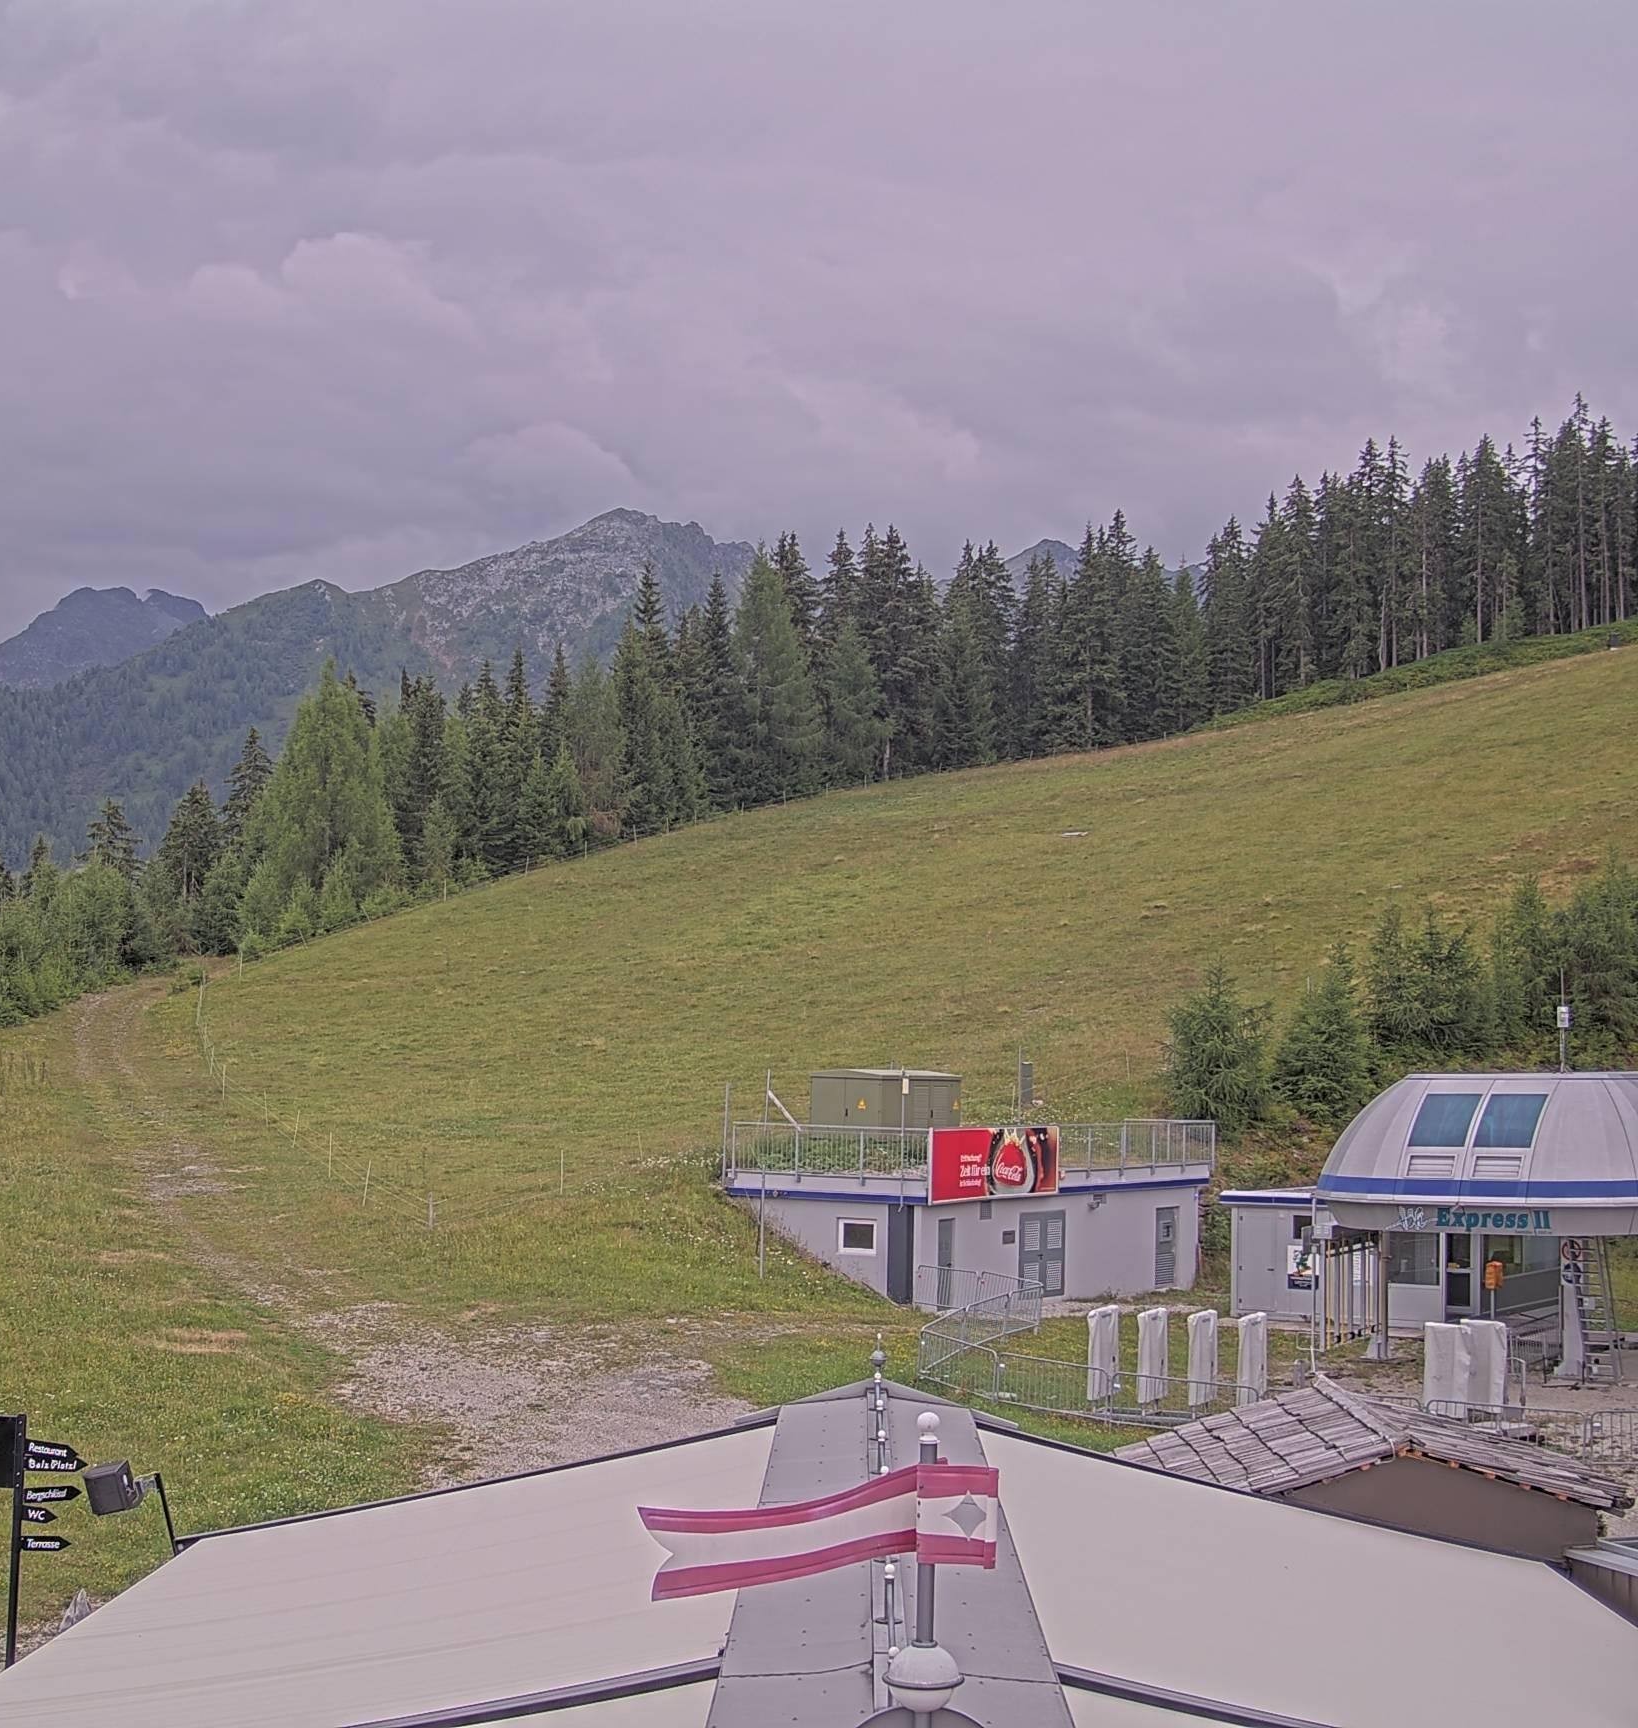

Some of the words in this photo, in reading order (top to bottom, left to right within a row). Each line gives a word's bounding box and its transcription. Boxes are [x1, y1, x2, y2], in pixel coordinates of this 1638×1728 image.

[1436, 1207, 1528, 1232] Express
[29, 1442, 67, 1457] Restaurant
[28, 1509, 46, 1520] WC
[27, 1538, 61, 1549] Terrasse
